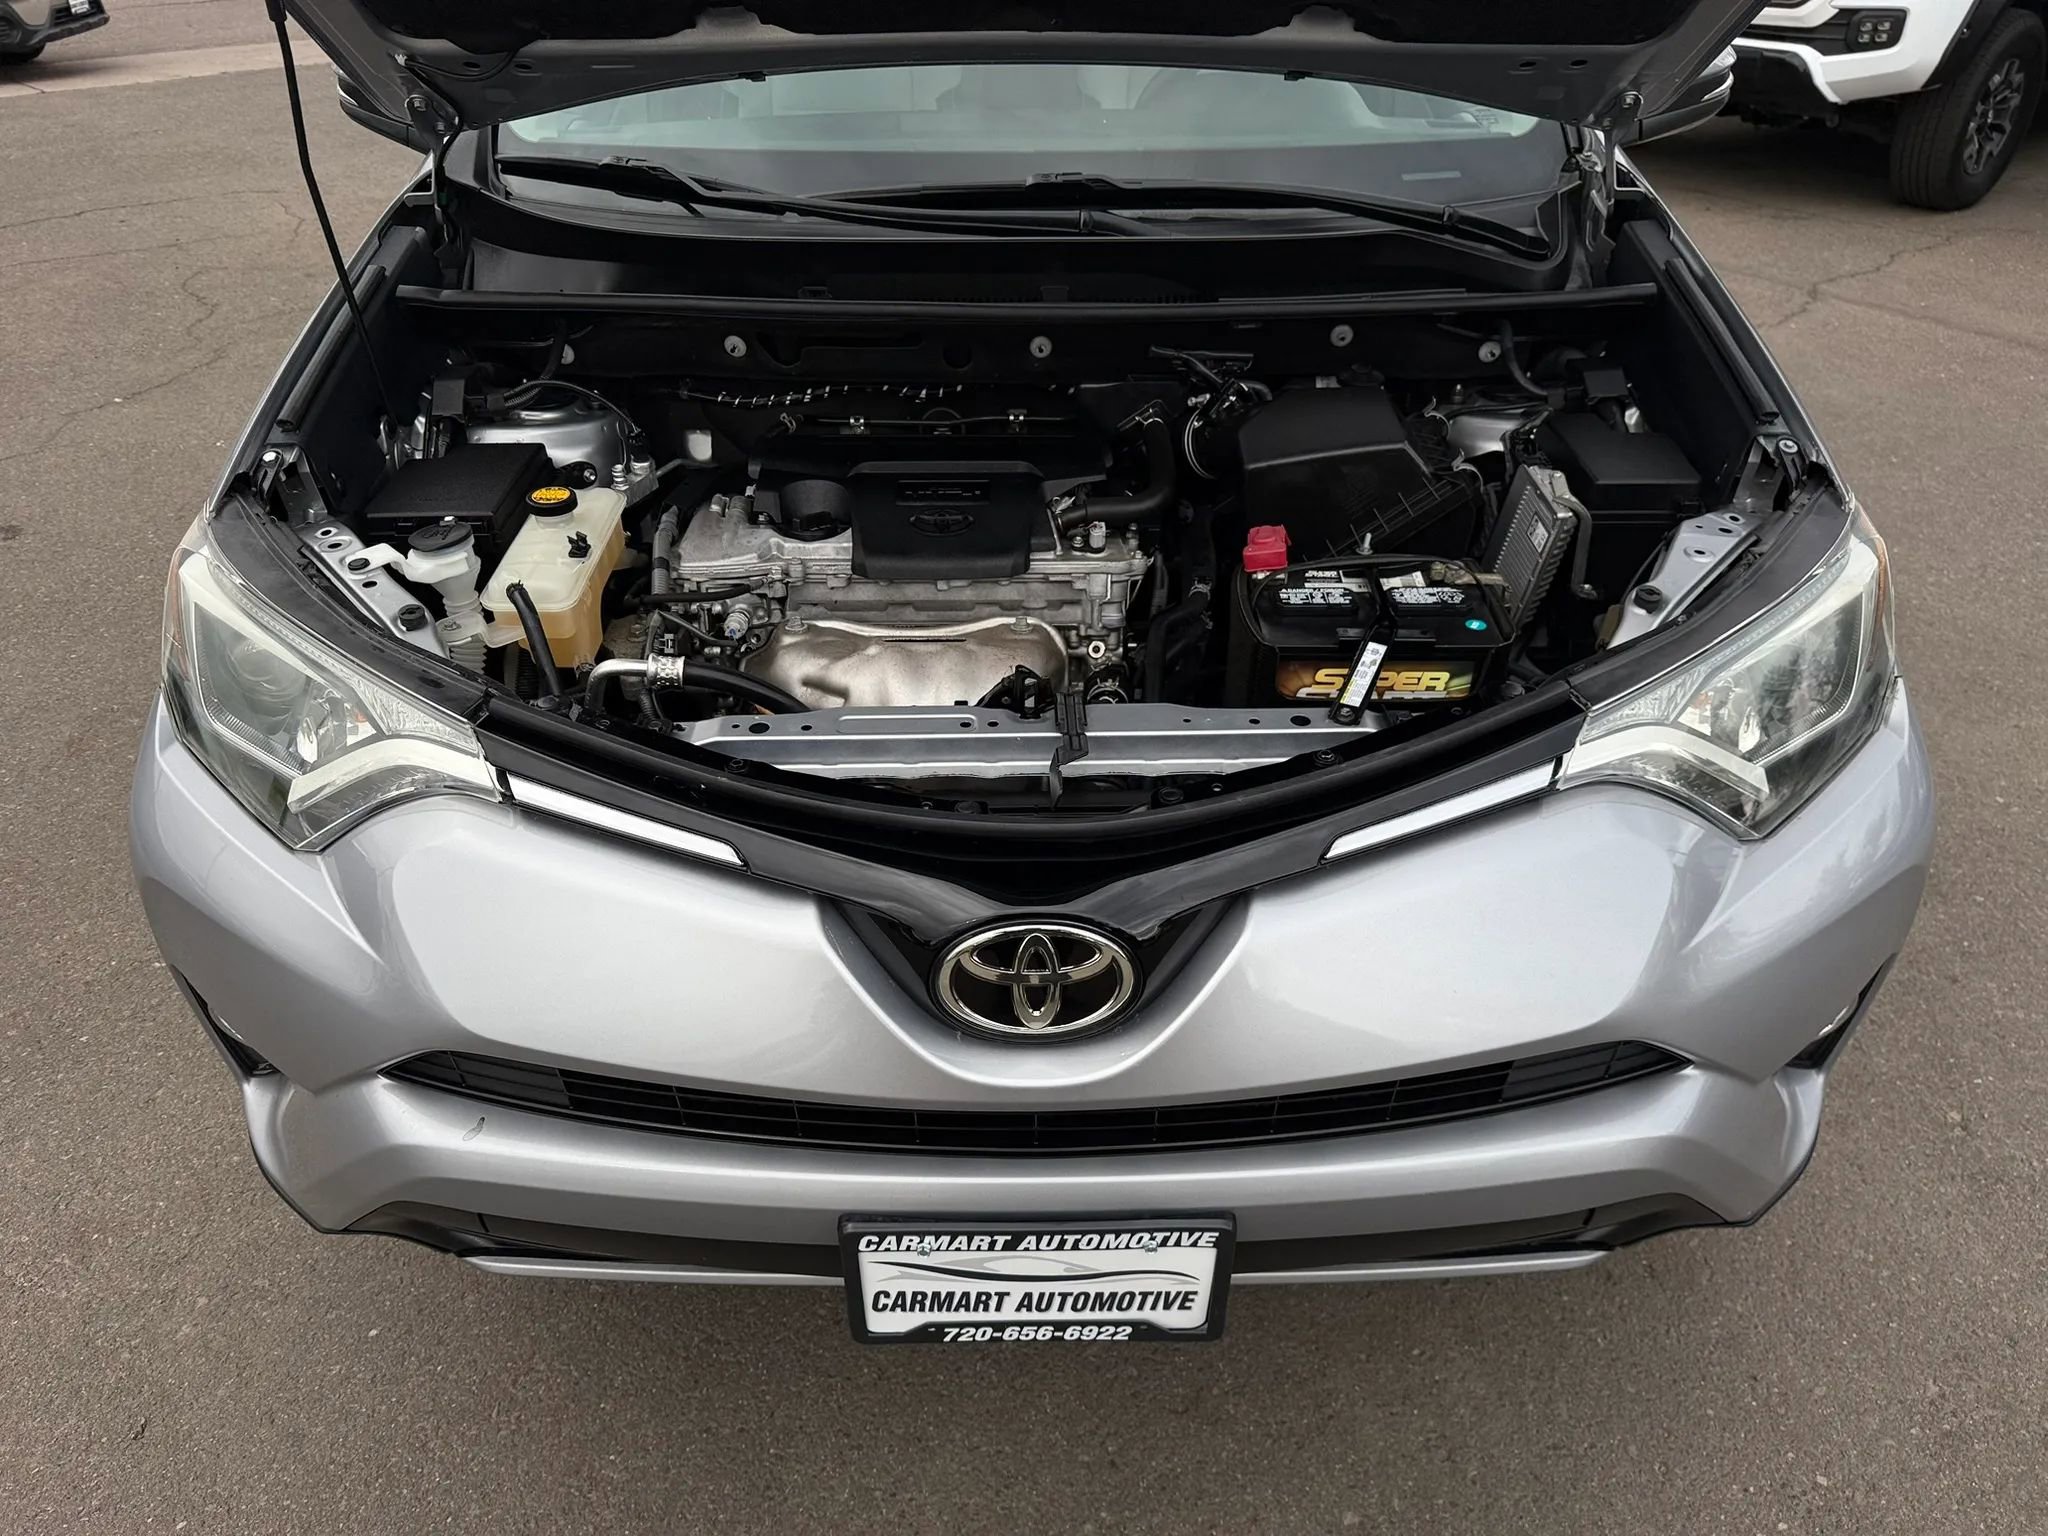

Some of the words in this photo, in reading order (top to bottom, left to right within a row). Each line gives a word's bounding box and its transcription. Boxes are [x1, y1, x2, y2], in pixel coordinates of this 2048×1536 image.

[1312, 668, 1450, 691] SPER
[858, 1235, 1011, 1252] CARMART
[1016, 1232, 1220, 1251] AUTOMOTIVE
[871, 1290, 1011, 1313] CARMART
[1015, 1290, 1199, 1312] AUTOMOTIVE
[942, 1325, 1133, 1342] 720-656-6922
